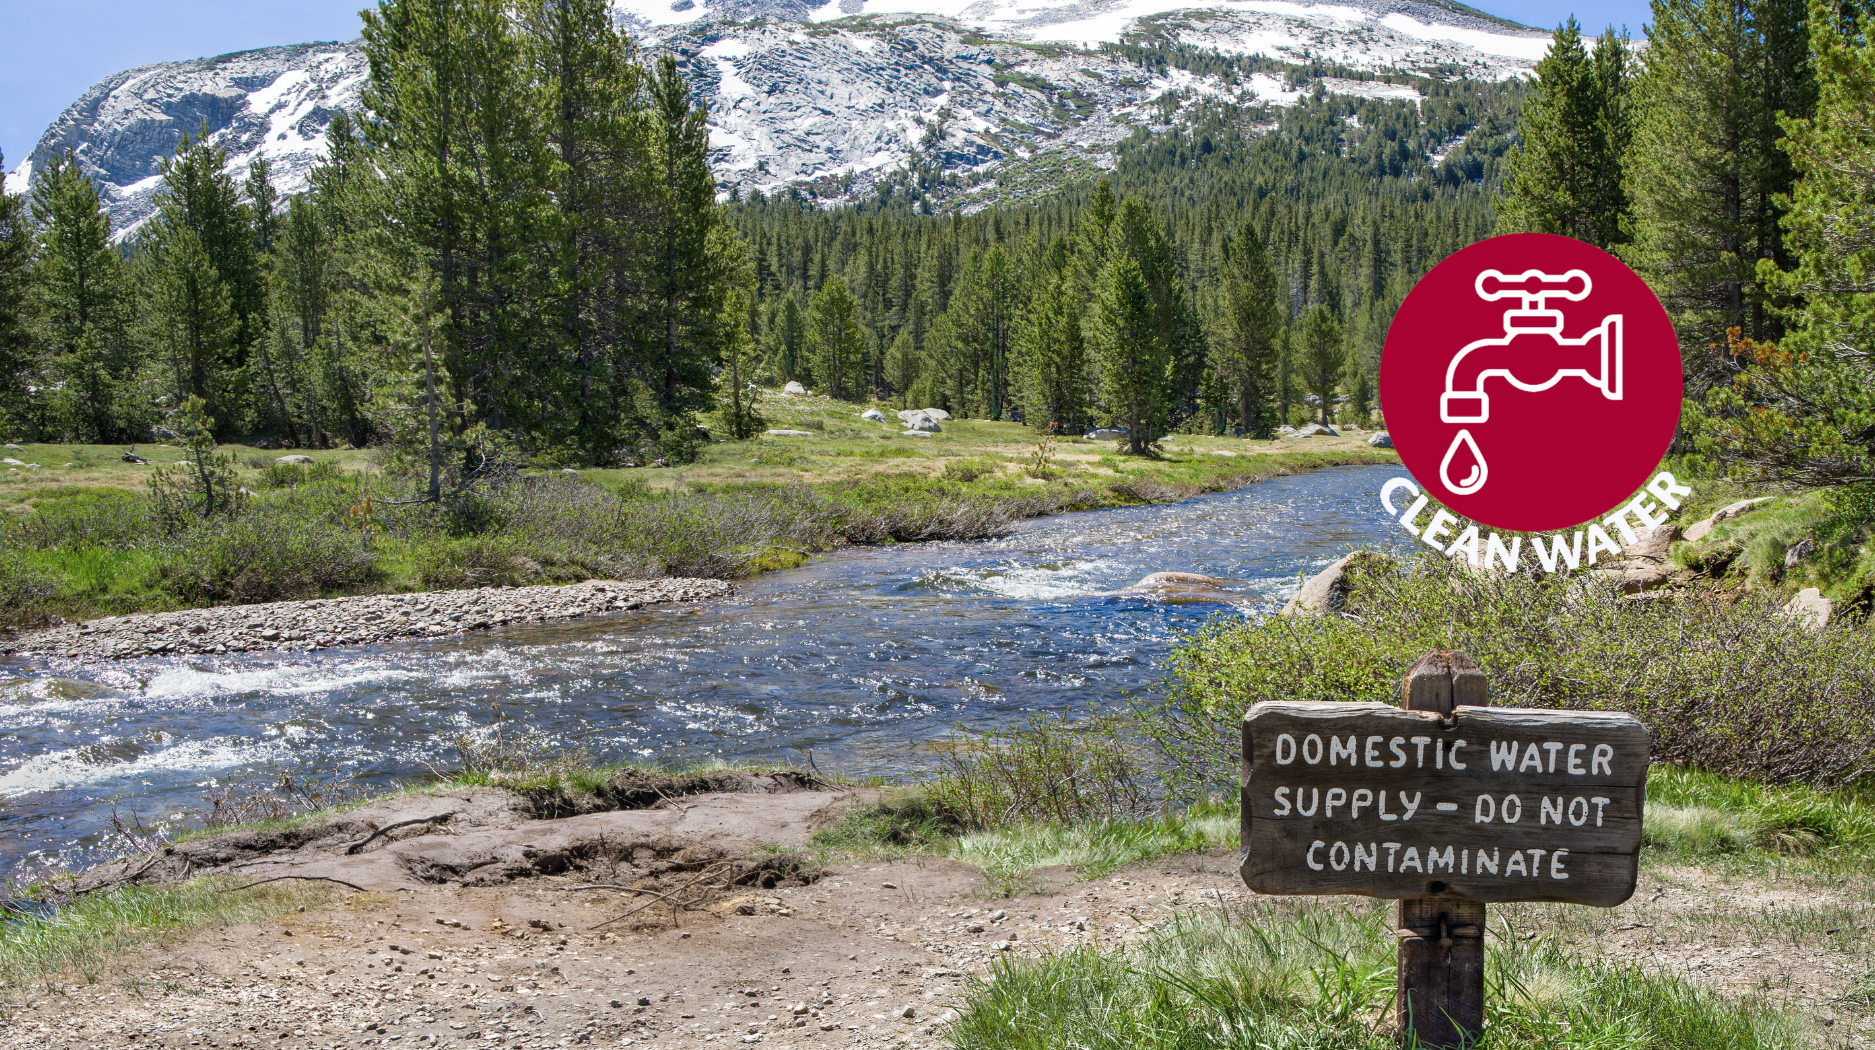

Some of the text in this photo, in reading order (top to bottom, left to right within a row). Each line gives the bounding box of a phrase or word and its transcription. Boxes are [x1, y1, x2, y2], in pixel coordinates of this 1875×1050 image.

[1275, 733, 1613, 776] DOMESTIC WATER
[1273, 786, 1422, 821] SUPPLY
[1475, 793, 1522, 824] DO
[1540, 796, 1611, 827] NOT
[1306, 840, 1569, 880] CONTAMINATE
